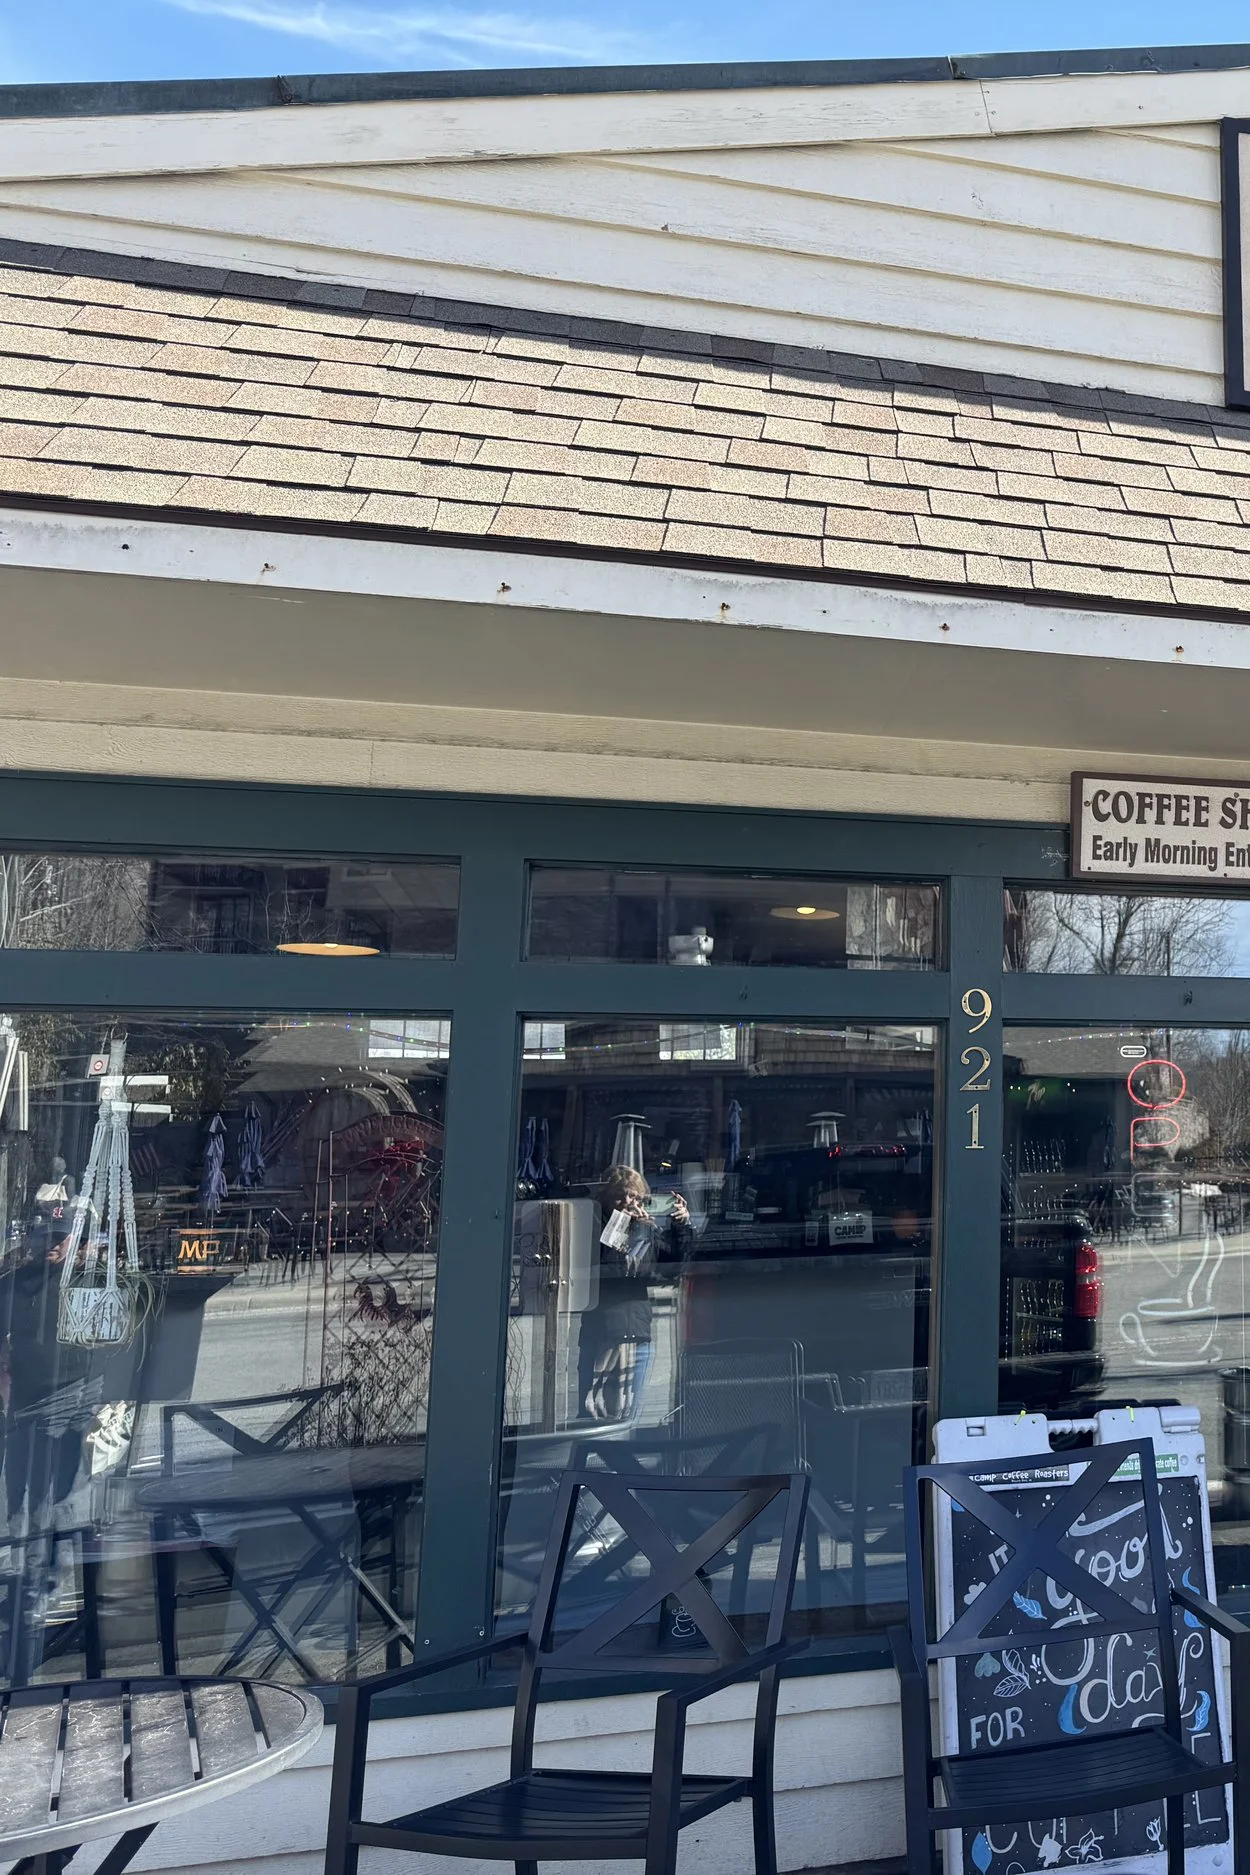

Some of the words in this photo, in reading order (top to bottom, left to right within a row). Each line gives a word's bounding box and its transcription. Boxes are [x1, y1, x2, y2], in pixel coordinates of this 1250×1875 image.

[1092, 789, 1210, 827] COFFEE
[1092, 835, 1138, 868] Early
[1144, 838, 1218, 872] Morning
[960, 988, 992, 1150] 921
[834, 1225, 866, 1235] CAMP
[1034, 1469, 1068, 1480] Roasters
[970, 1706, 1026, 1750] FOR
